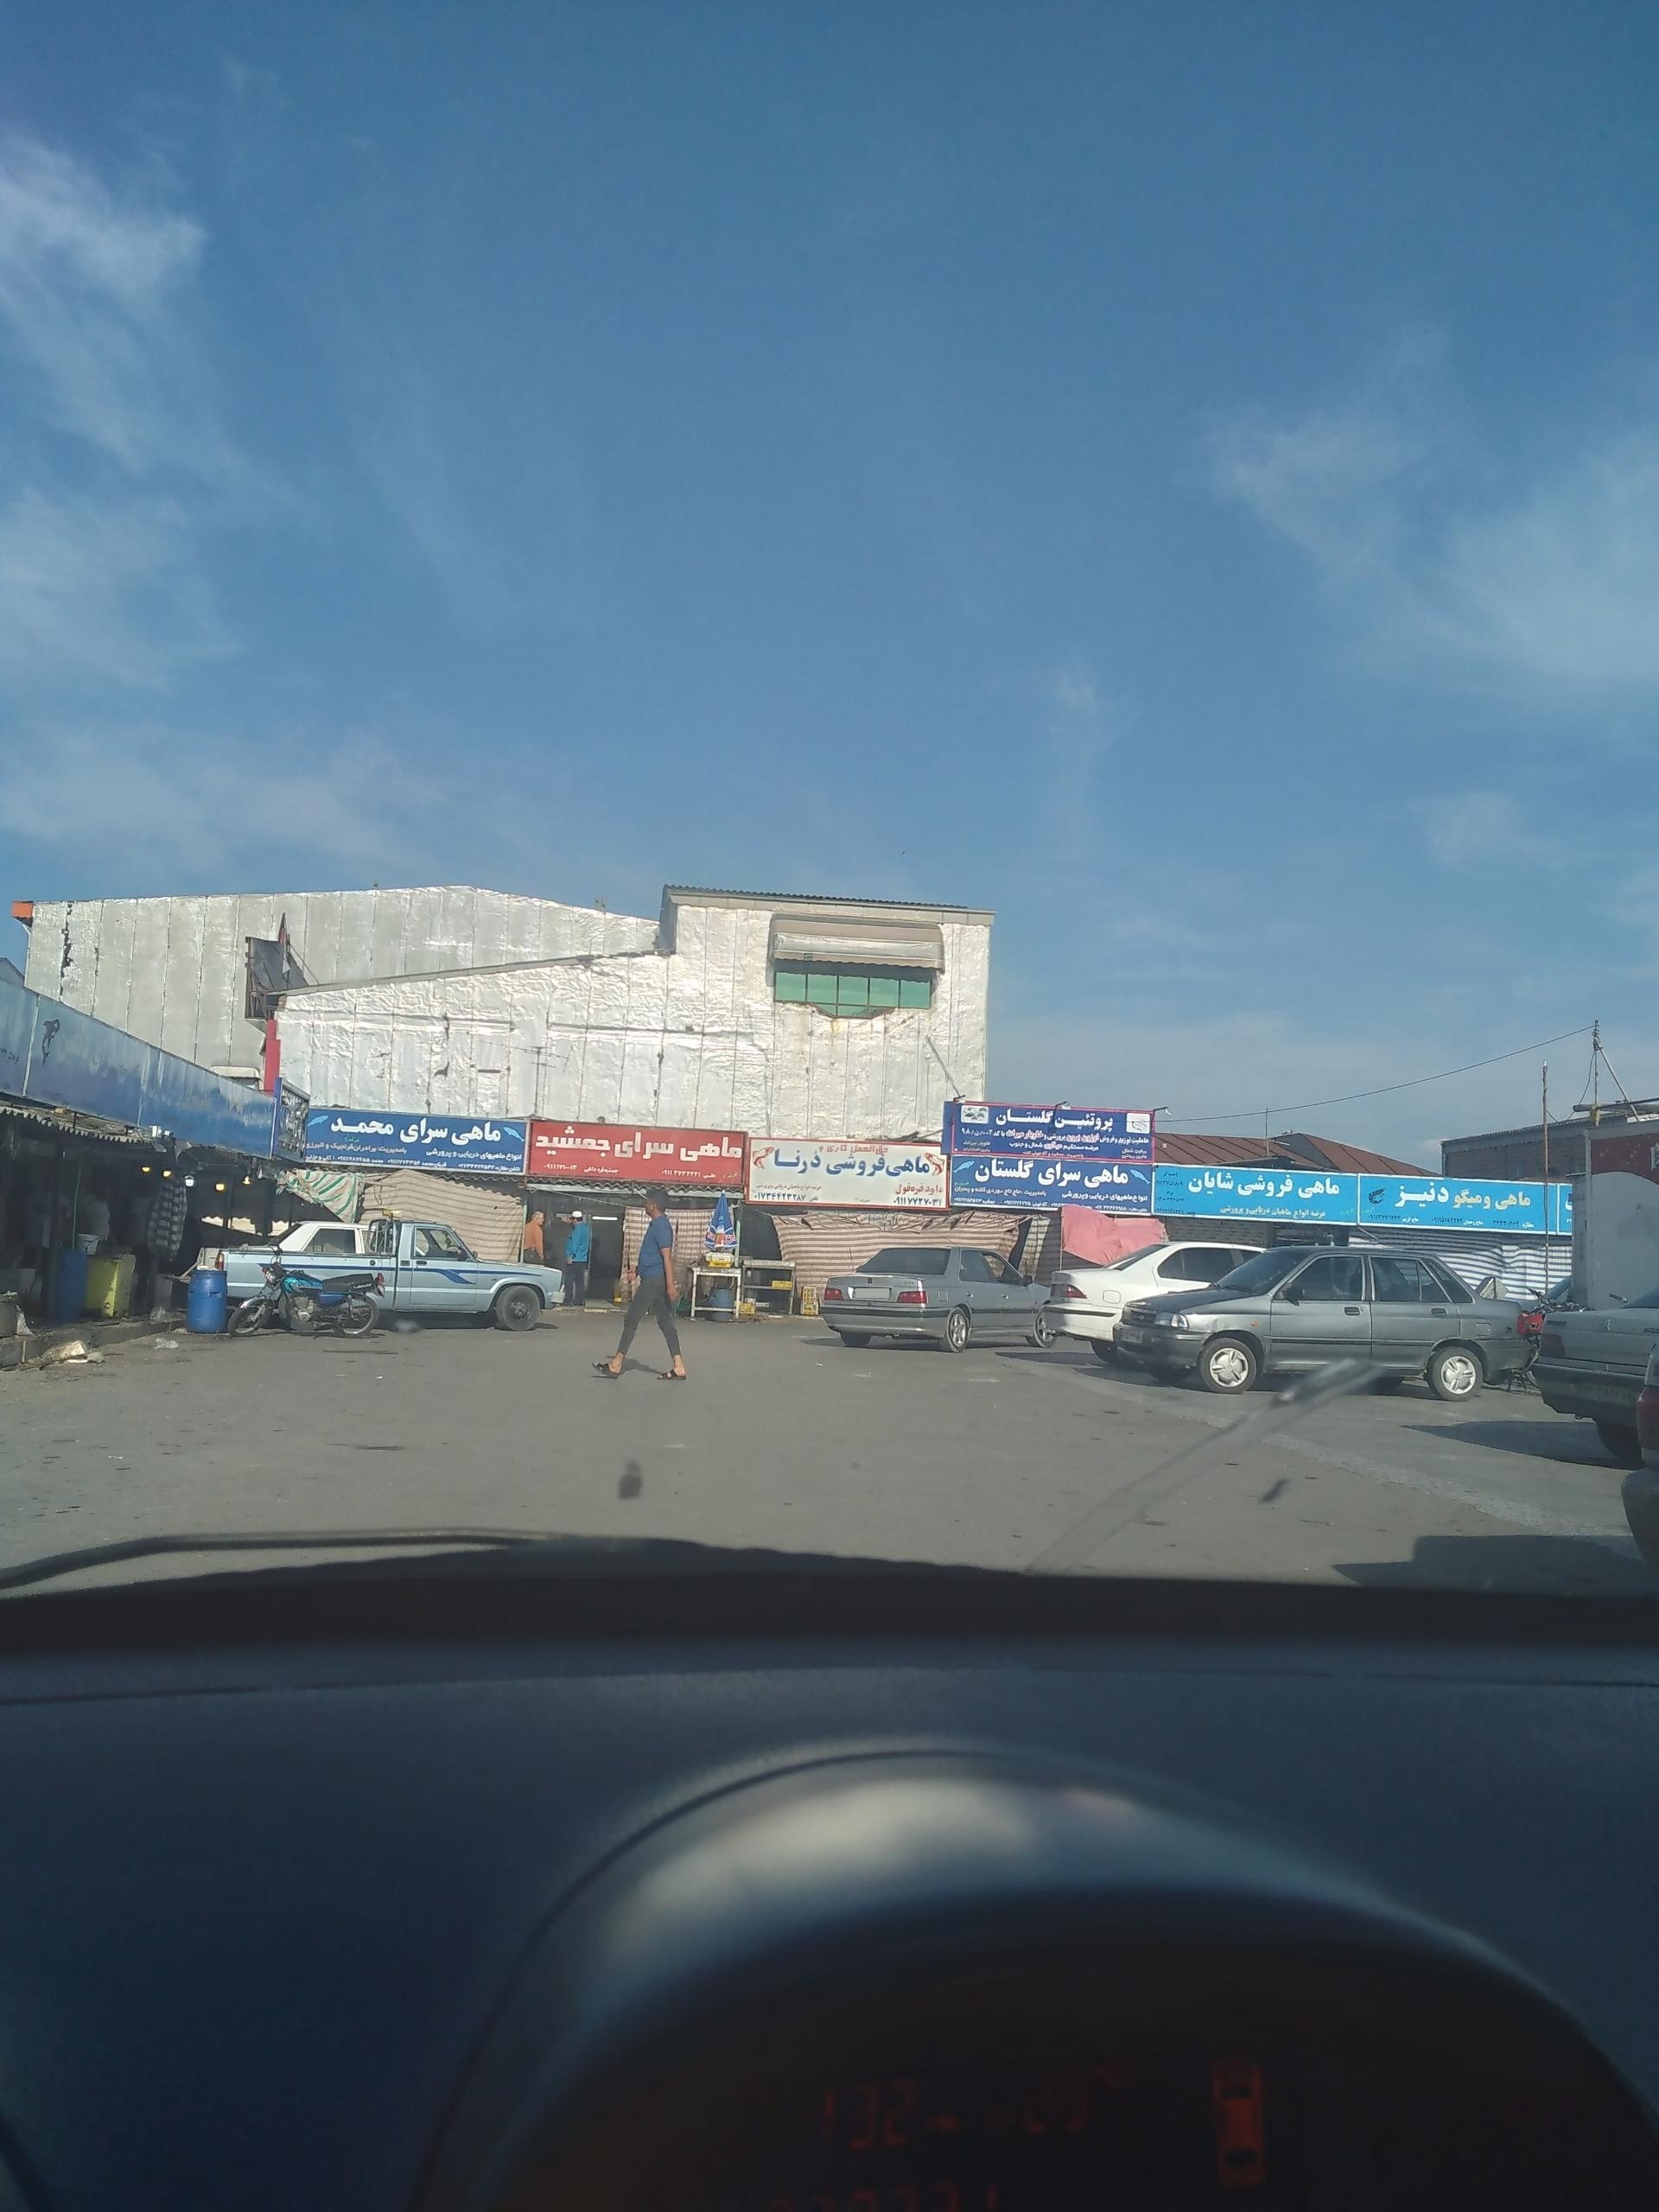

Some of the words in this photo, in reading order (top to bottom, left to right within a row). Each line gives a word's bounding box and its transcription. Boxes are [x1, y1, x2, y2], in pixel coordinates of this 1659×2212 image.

[331, 1117, 394, 1135] محمد
[995, 1108, 1053, 1126] گلستان
[1054, 1113, 1114, 1132] پروتئین
[400, 1117, 448, 1143] سرای
[451, 1122, 501, 1146] ماهی
[536, 1125, 611, 1158] جمشید
[614, 1131, 674, 1160] سرای
[680, 1136, 742, 1161] ماهی
[826, 1153, 886, 1176] فروشی
[885, 1154, 930, 1176] ماهی
[975, 1158, 1034, 1182] گلستان
[1038, 1161, 1081, 1187] سرای
[1084, 1165, 1128, 1188] ماهی
[1188, 1171, 1234, 1194] شایان
[1237, 1174, 1294, 1198] فروشی
[1298, 1177, 1340, 1198] ماهی
[1394, 1181, 1450, 1208] دنیز
[1452, 1188, 1482, 1208] میگو
[1483, 1195, 1491, 1210] و
[1495, 1191, 1531, 1211] ماهی
